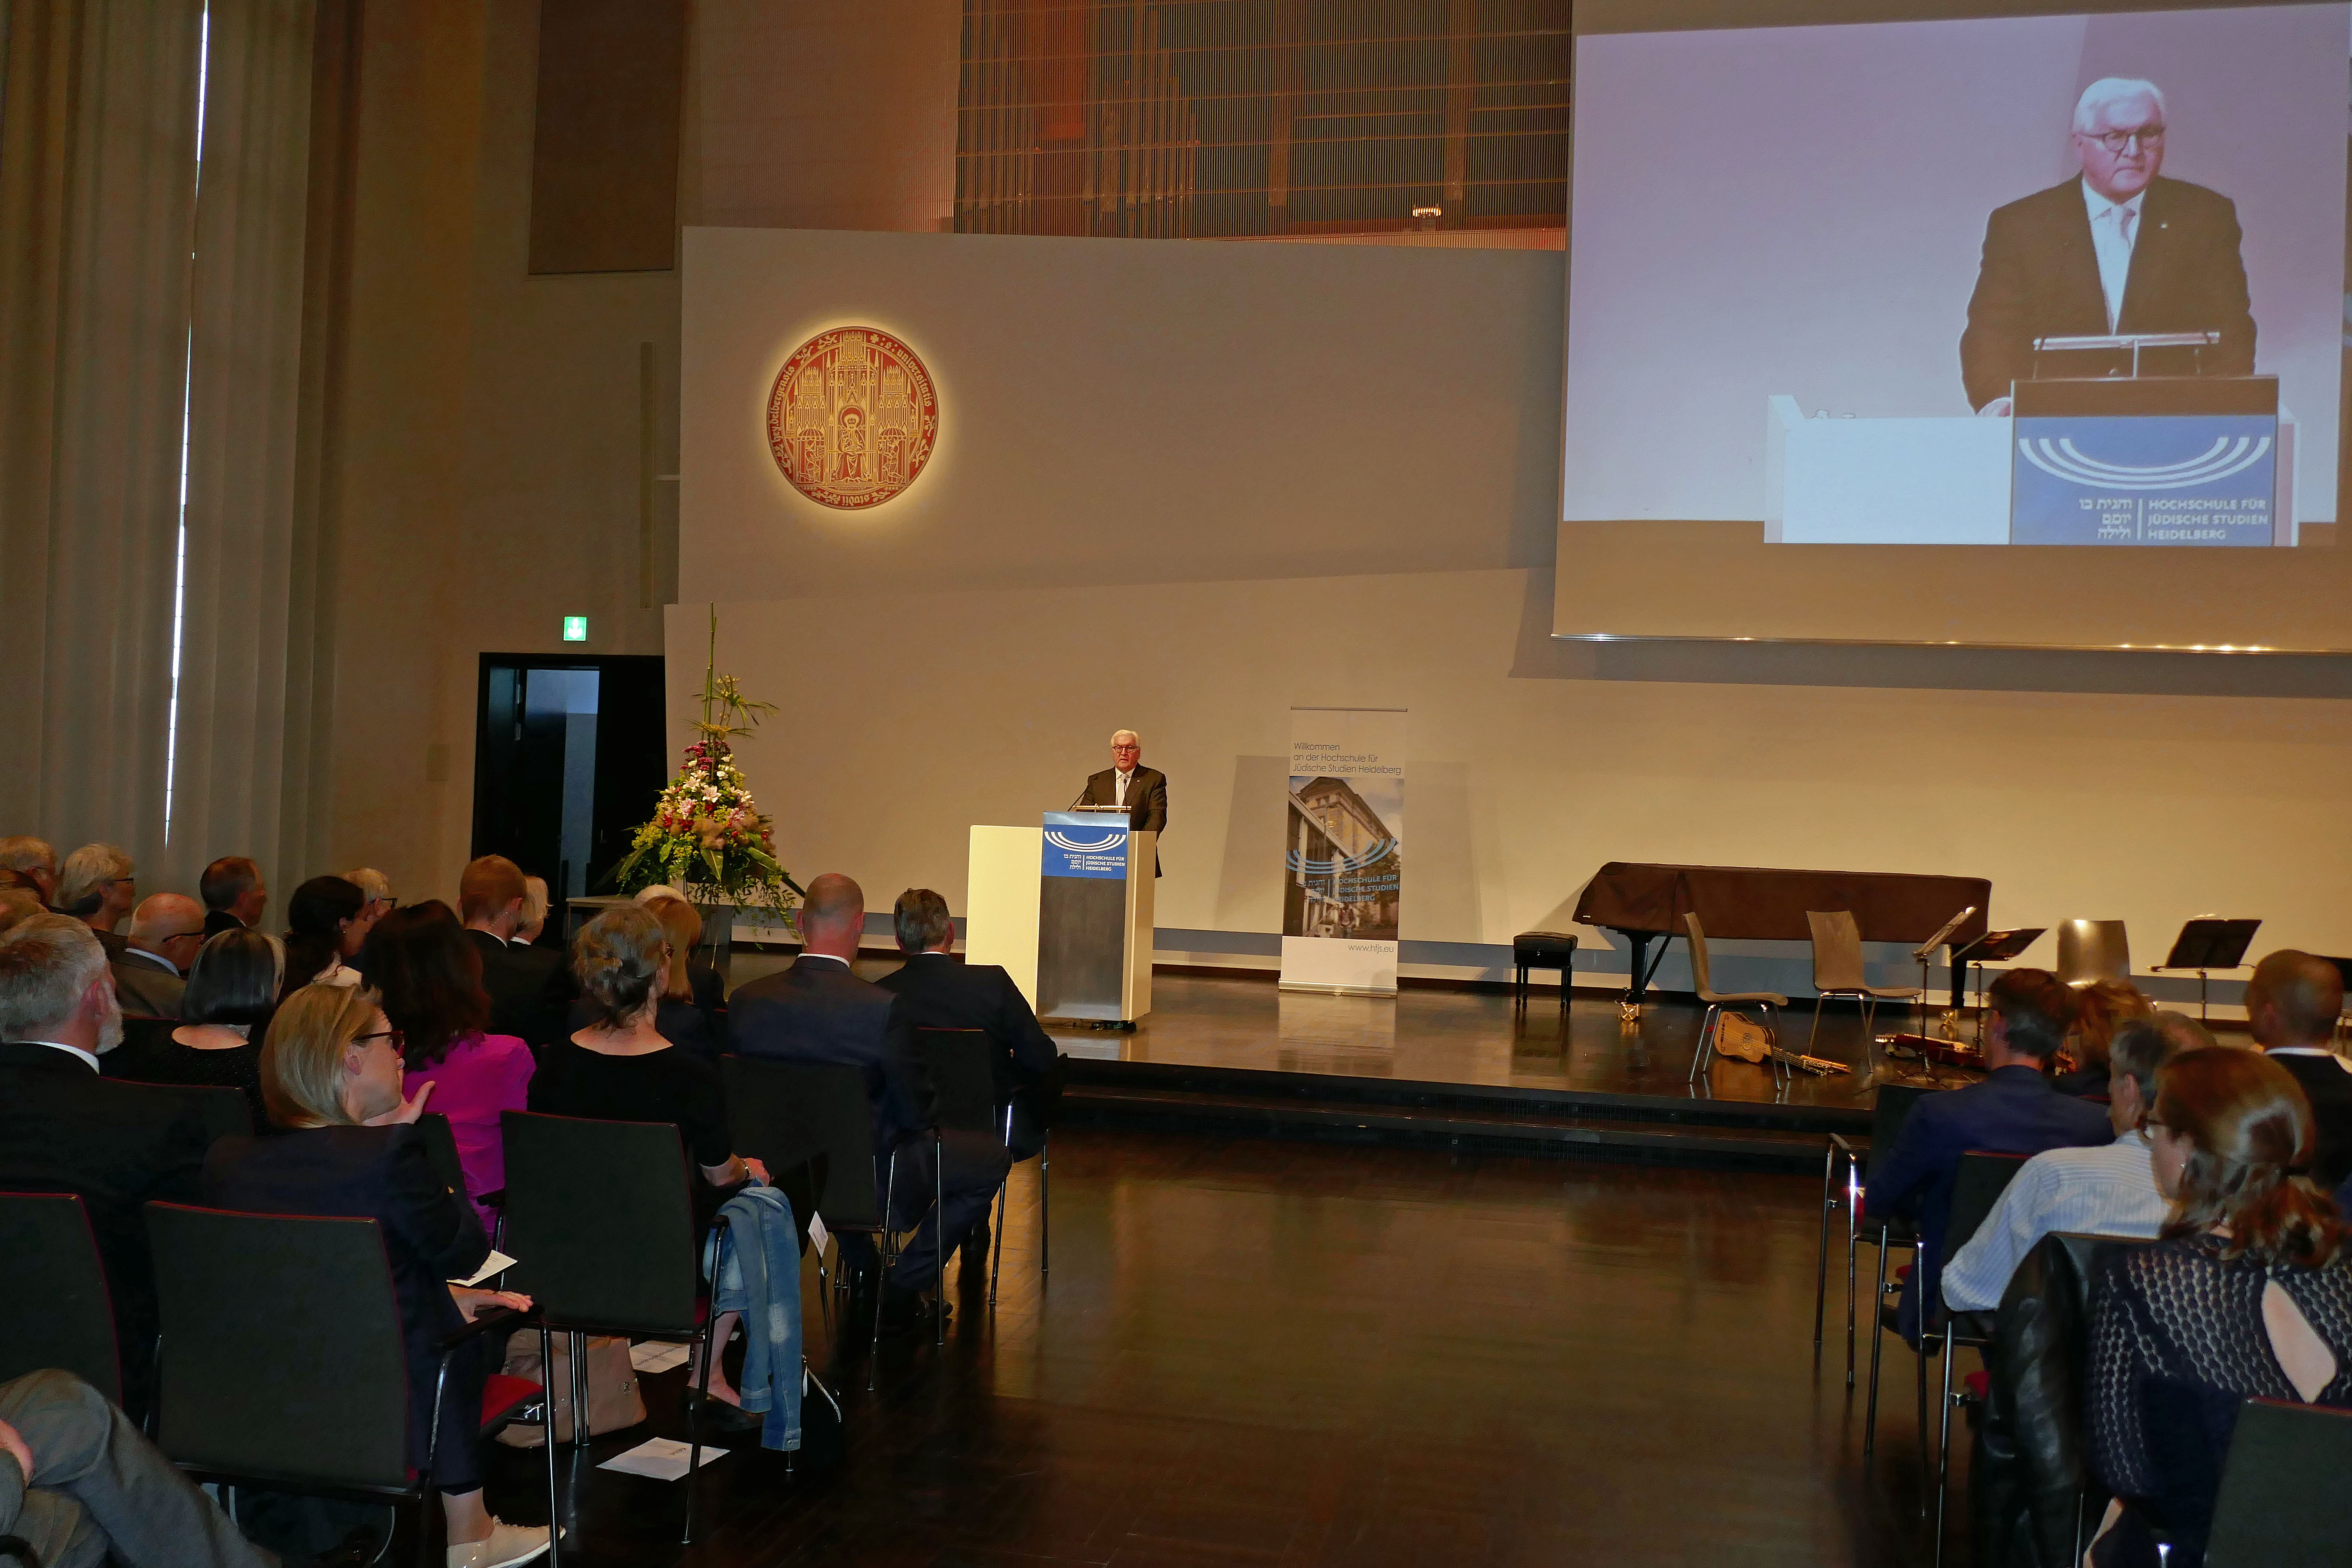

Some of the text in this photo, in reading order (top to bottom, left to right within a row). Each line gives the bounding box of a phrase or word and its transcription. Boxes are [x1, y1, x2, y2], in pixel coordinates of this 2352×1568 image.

[2148, 498, 2267, 510] HOCHSCHULE FÜR
[2148, 513, 2269, 526] JÜDISCHE STUDIEN
[2148, 529, 2227, 540] HEIDELBERG
[1294, 742, 1340, 751] Willkommen
[1321, 753, 1366, 762] Hochschule
[1368, 754, 1378, 763] für
[1293, 763, 1401, 775] Jüdische Studien Heidelberg
[1348, 944, 1394, 954] www.hfjs.eu
